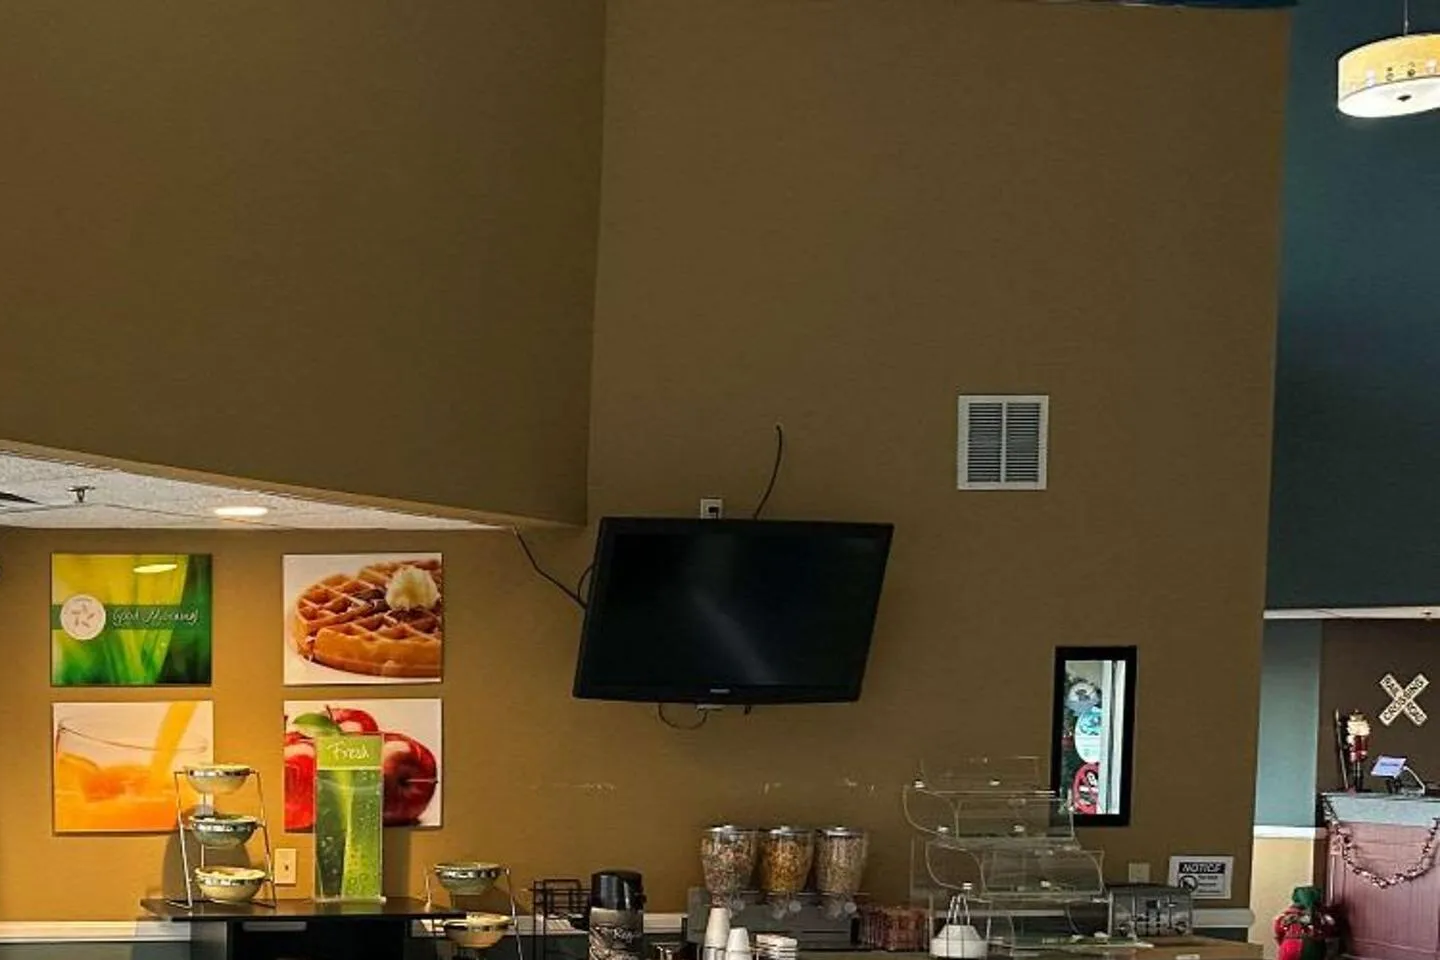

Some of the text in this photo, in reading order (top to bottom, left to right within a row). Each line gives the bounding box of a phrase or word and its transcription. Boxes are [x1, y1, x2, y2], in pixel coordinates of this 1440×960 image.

[1383, 678, 1424, 720] CROSSING
[326, 740, 369, 760] Fresh
[1182, 863, 1222, 873] NOTICE
